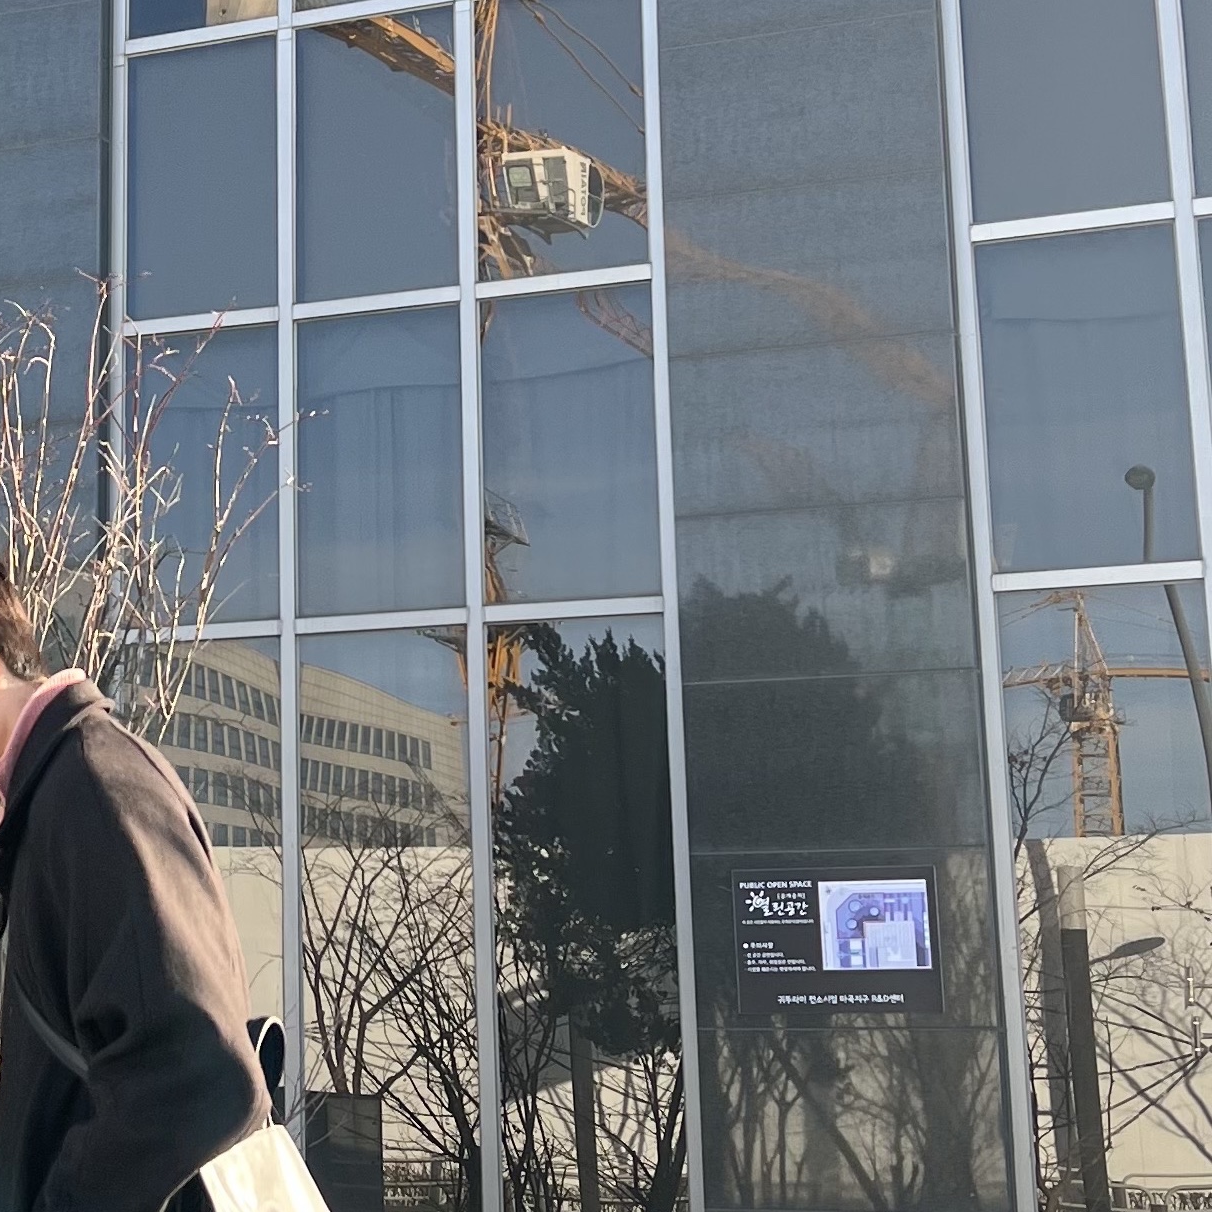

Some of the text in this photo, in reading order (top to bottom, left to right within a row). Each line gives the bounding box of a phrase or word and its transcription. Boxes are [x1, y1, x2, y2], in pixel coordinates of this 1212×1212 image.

[739, 880, 813, 889] PUBLIC OPEN SPACE
[745, 890, 809, 917] 열린공간
